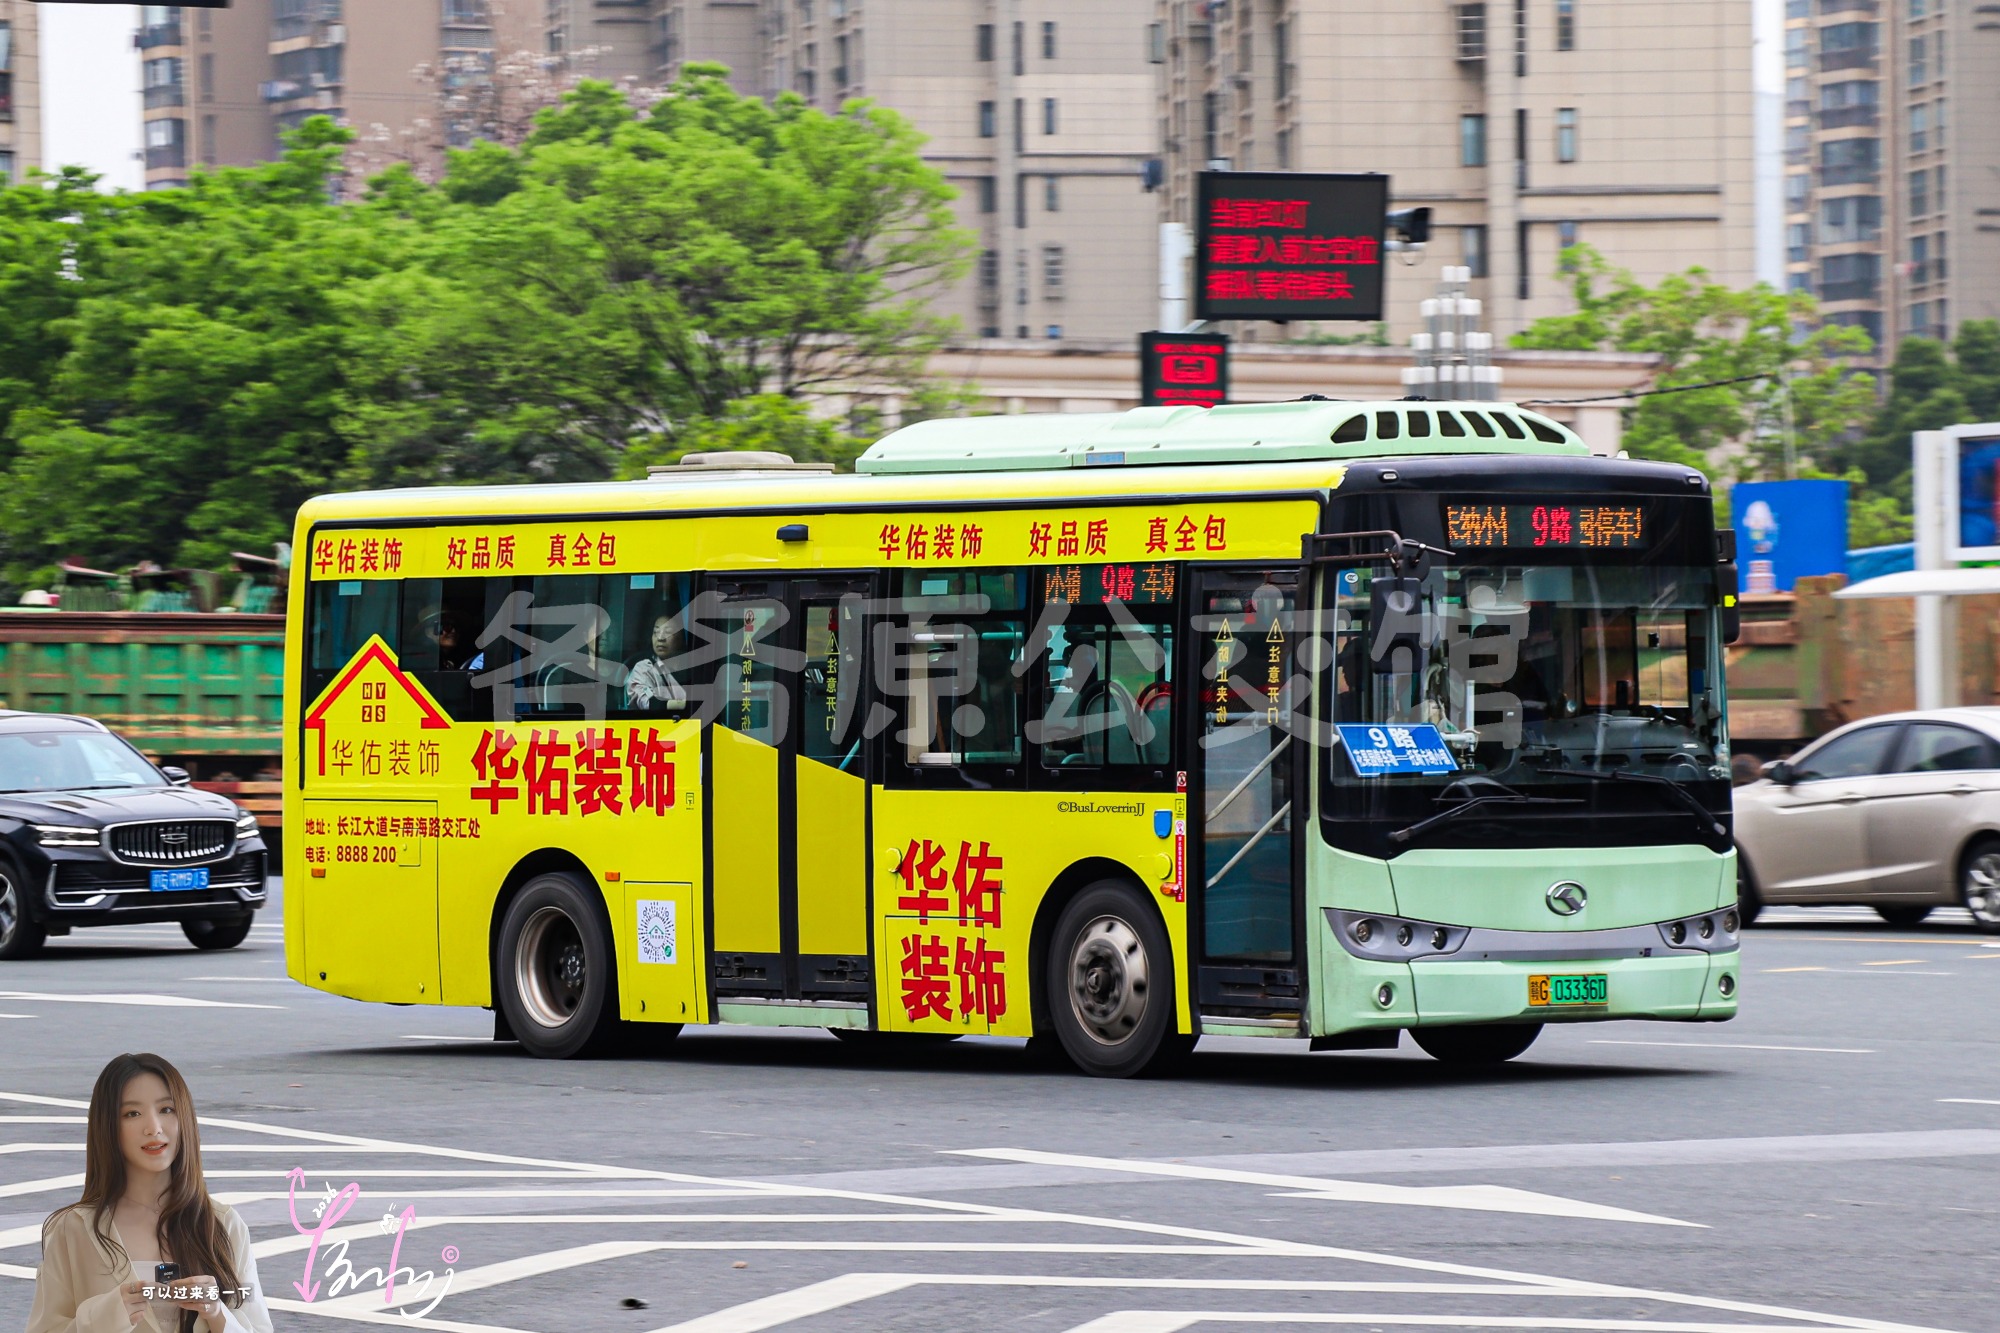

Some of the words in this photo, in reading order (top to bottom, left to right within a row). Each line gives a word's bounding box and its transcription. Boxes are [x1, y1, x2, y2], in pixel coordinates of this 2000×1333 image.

[315, 537, 403, 575] 华佑装饰
[447, 534, 516, 570] 好品质
[547, 532, 616, 568] 真全包
[879, 523, 983, 561] 华佑装饰
[1029, 519, 1109, 558] 好品质
[1145, 514, 1226, 554] 真全包
[331, 739, 440, 777] 华佑装饰
[470, 727, 677, 818] 华佑装饰
